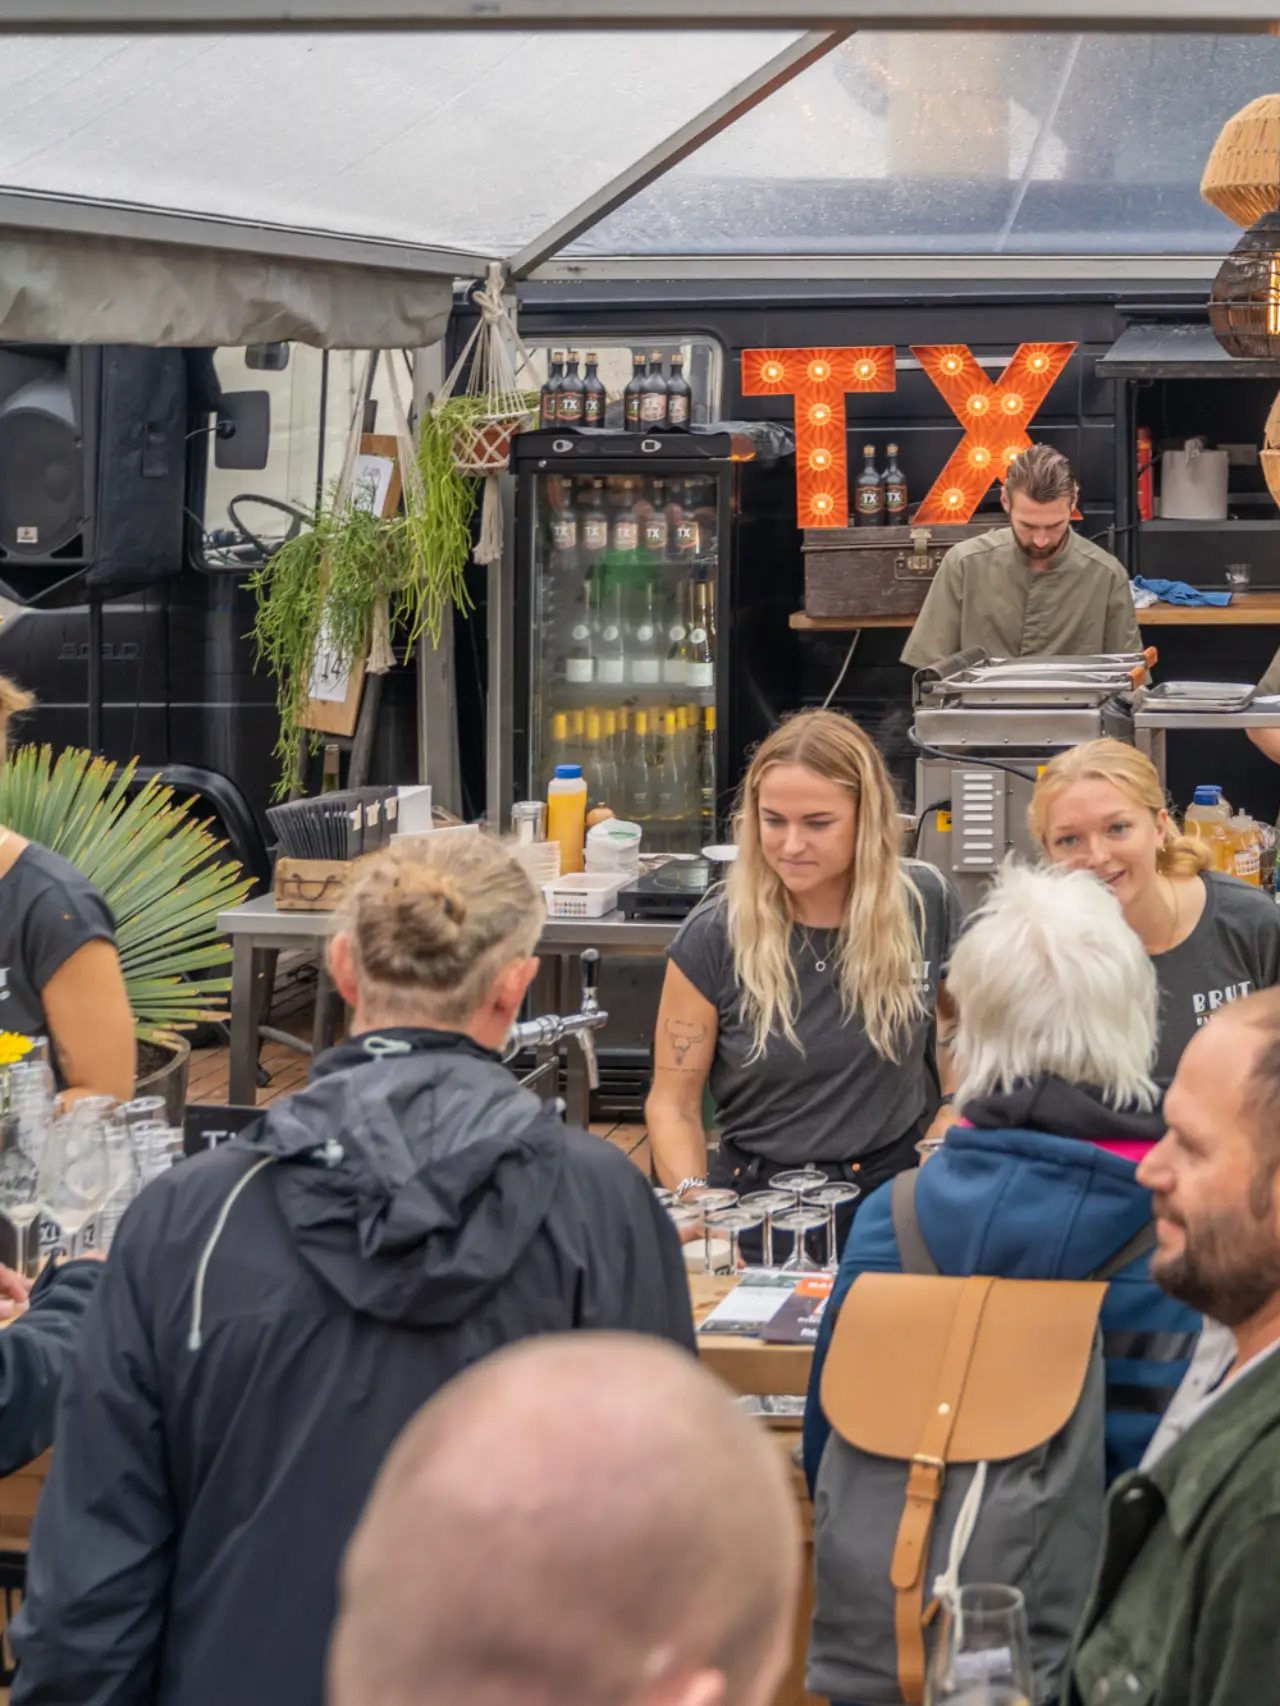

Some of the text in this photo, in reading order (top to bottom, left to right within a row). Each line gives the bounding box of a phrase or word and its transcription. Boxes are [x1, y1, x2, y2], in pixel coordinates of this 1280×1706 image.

[563, 399, 578, 409] TX
[741, 341, 1085, 528] TX
[862, 493, 877, 504] TX
[886, 491, 901, 502] TX
[554, 526, 568, 537] TX
[585, 526, 600, 537] TX
[617, 527, 631, 538] TX
[646, 527, 660, 539] TX
[677, 527, 692, 538] TX
[1192, 981, 1251, 1014] BRUT
